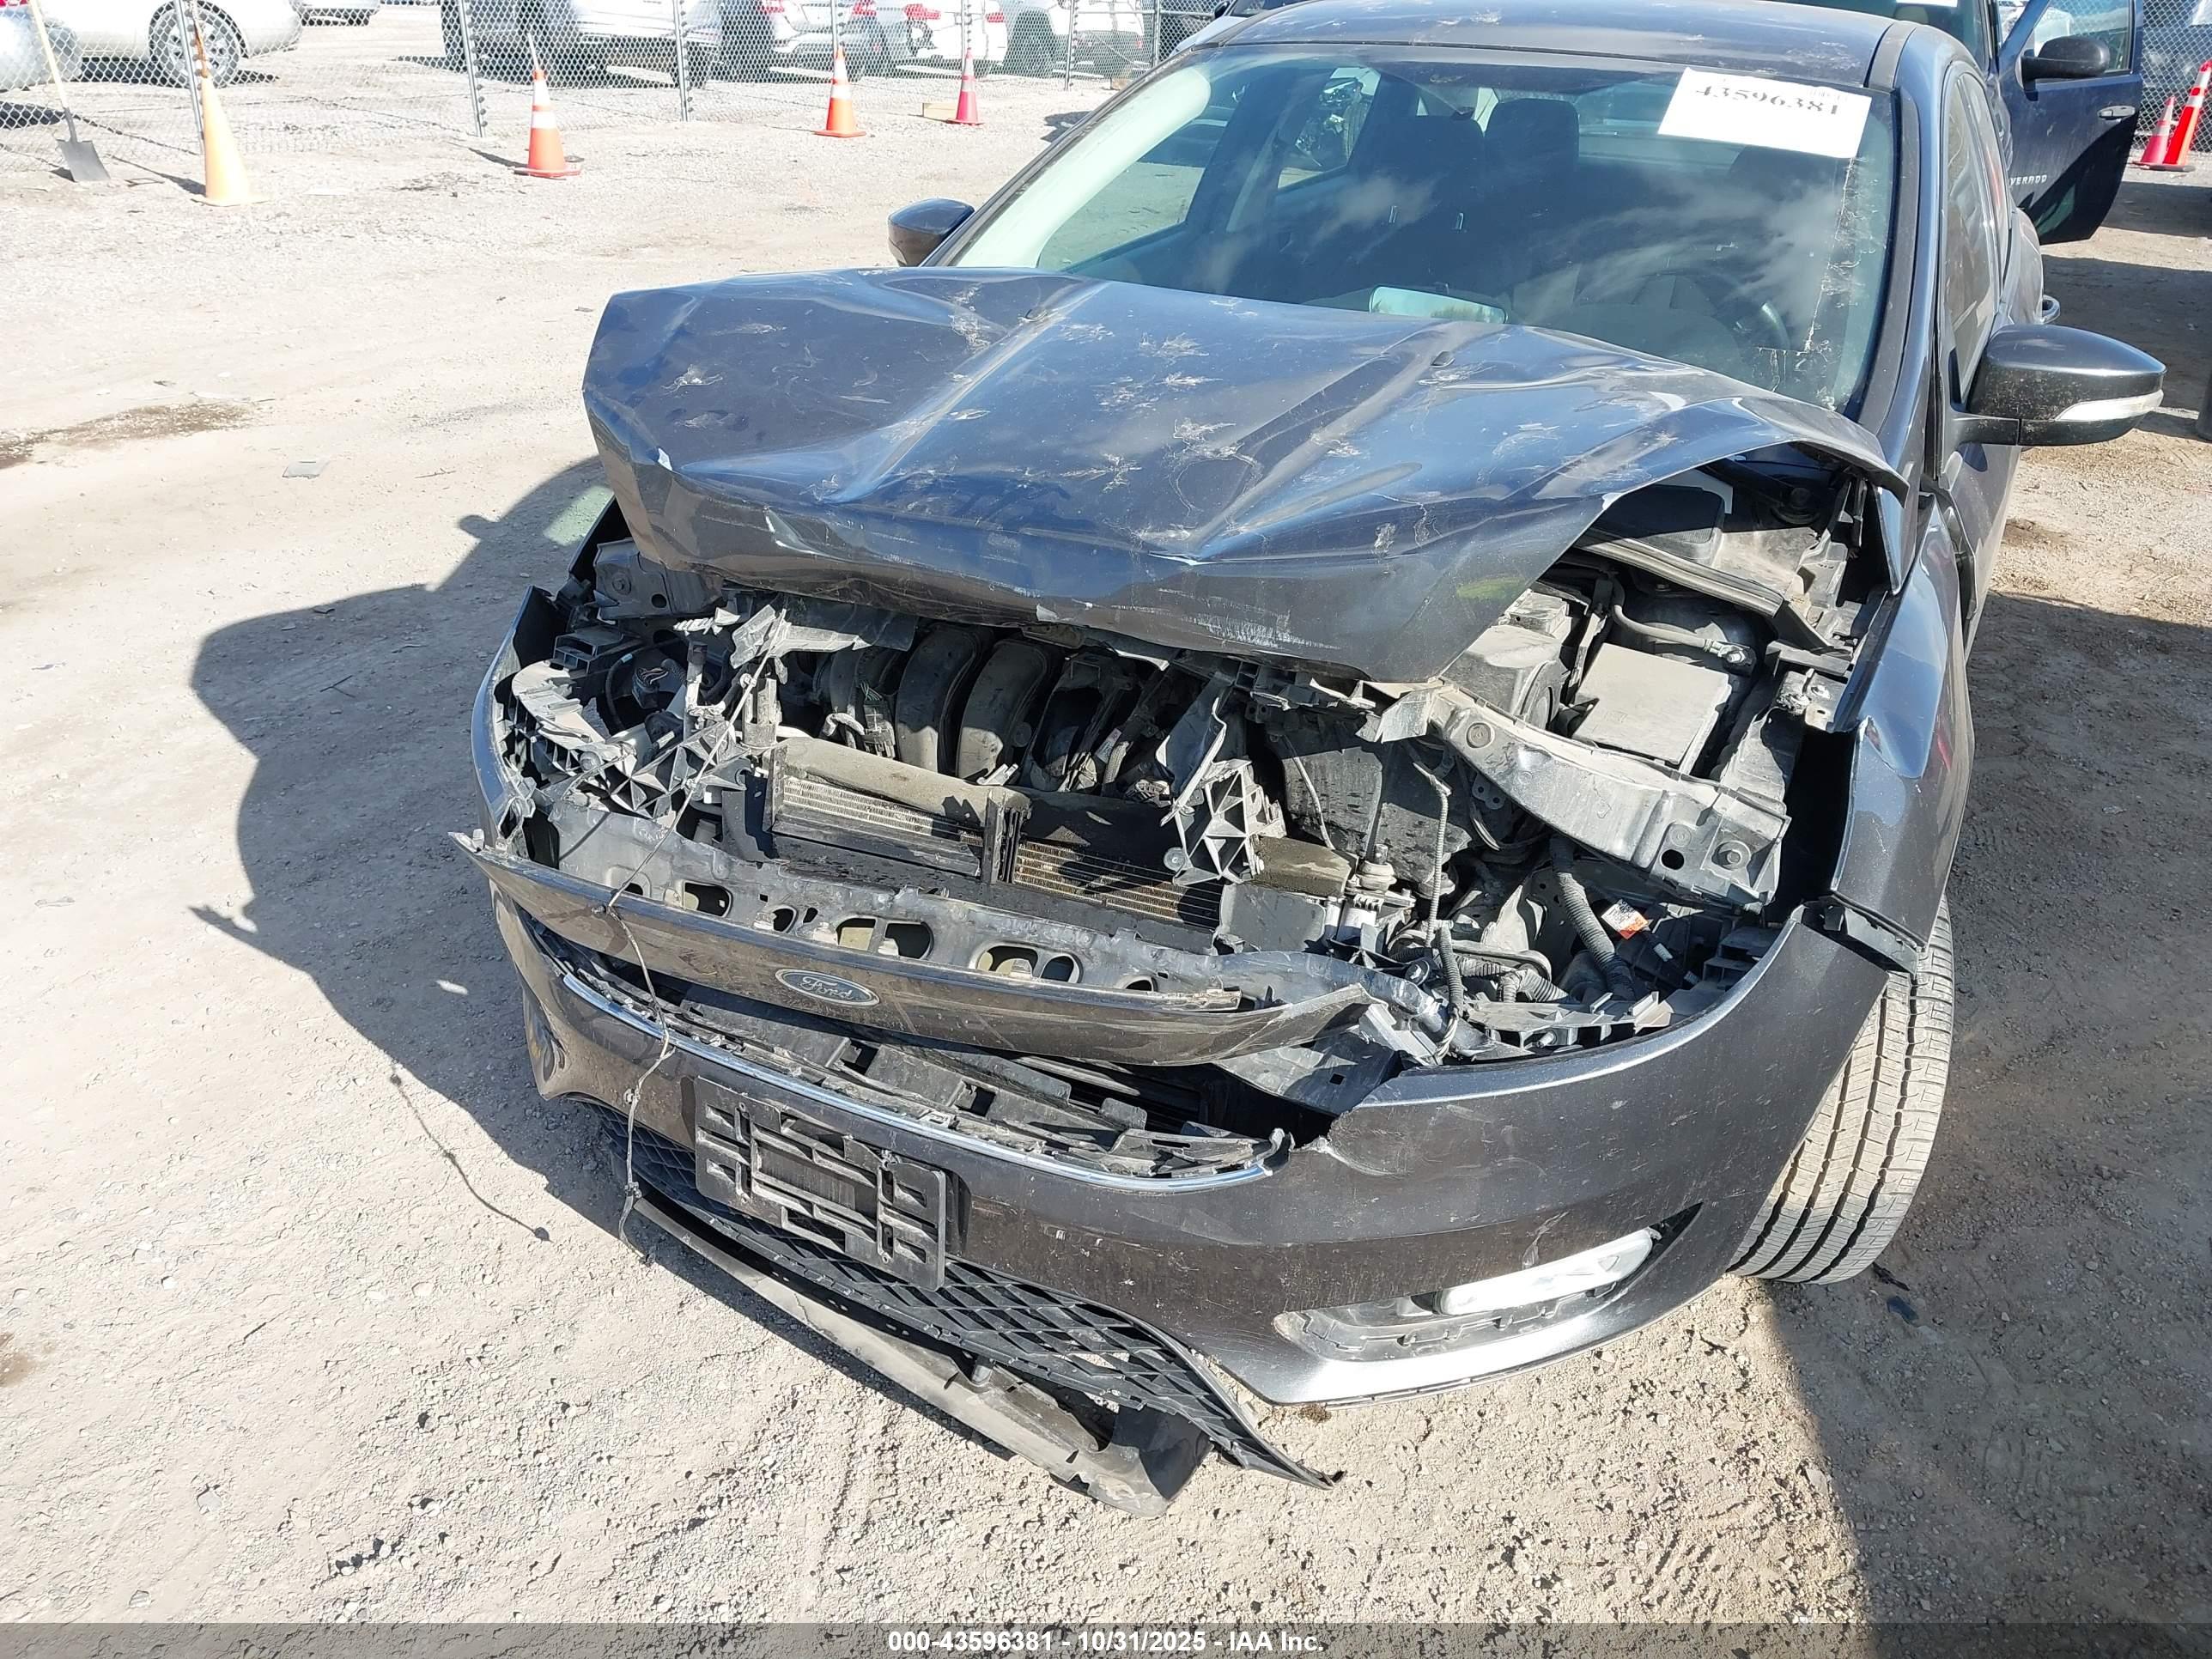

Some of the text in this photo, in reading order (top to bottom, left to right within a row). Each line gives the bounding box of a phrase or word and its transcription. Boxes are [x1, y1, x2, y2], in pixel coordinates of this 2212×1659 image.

[1696, 85, 1838, 115] 43596381
[2009, 174, 2047, 186] VERADO
[799, 975, 854, 1000] Ford
